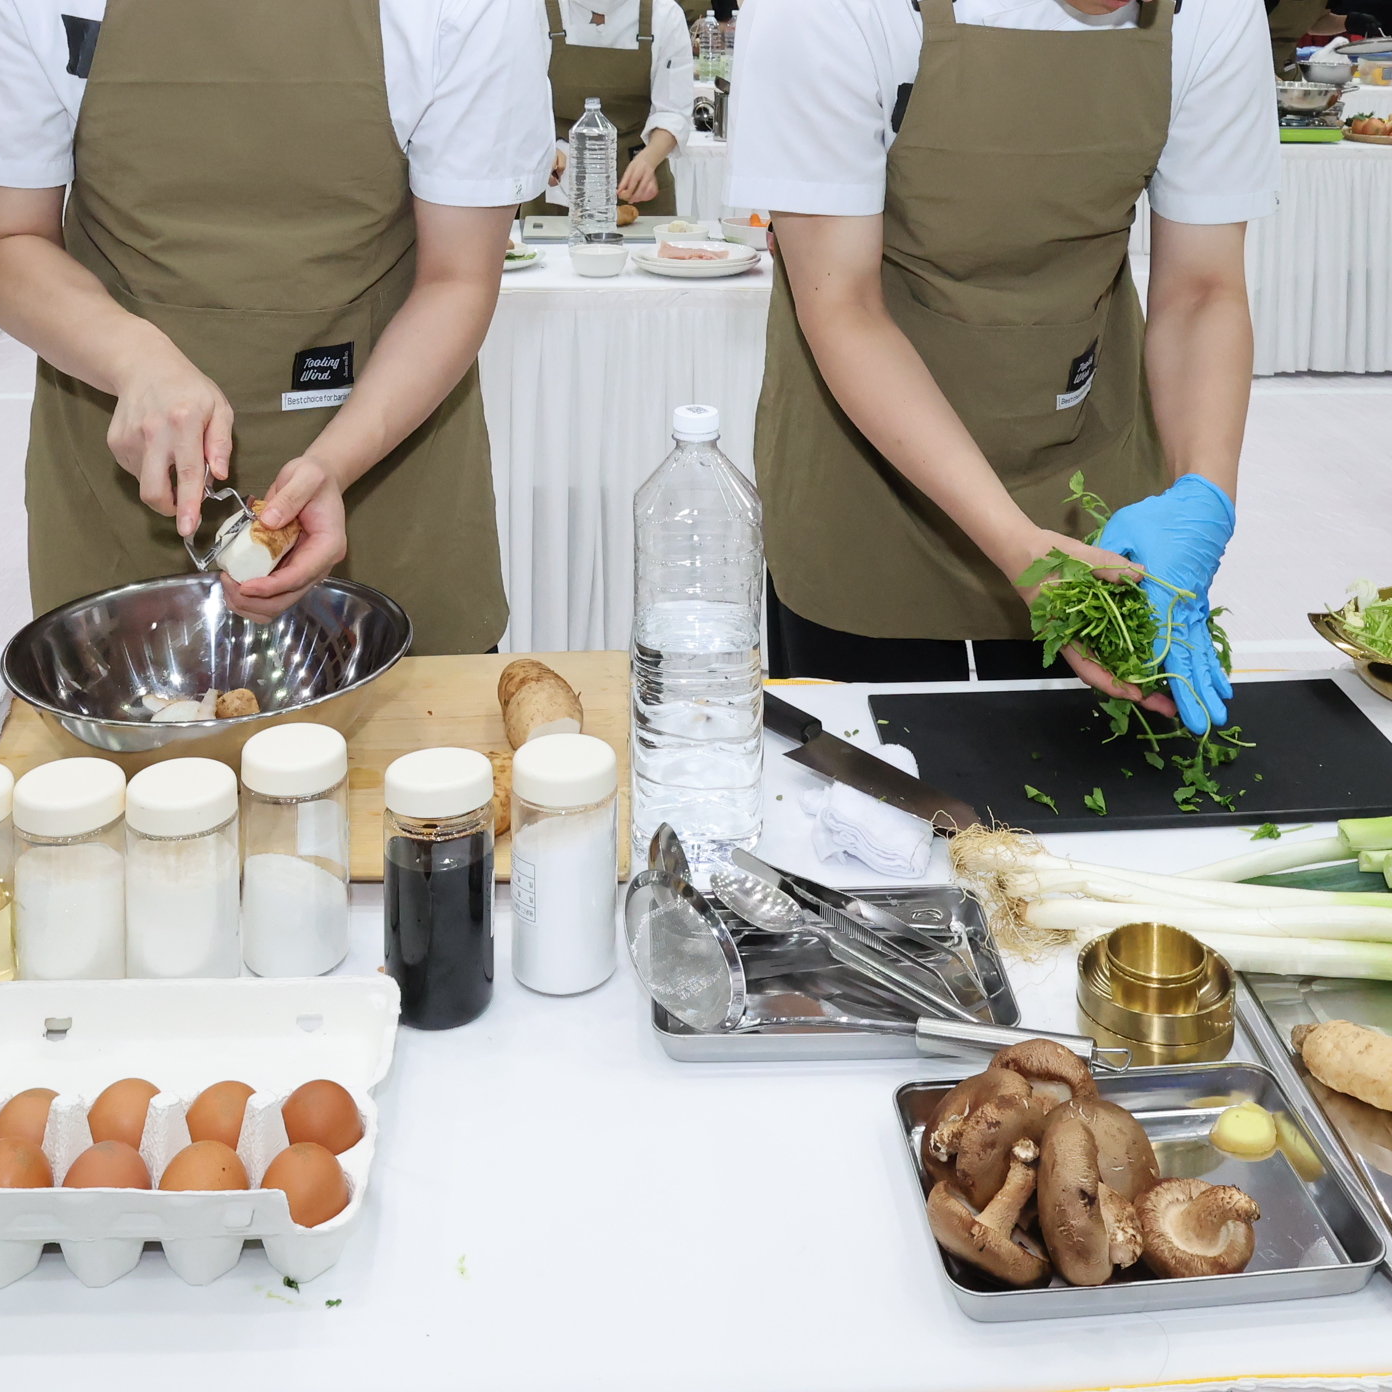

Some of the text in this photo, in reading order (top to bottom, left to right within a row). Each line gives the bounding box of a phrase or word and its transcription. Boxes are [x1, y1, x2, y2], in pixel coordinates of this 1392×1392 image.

[303, 356, 340, 370] Tooling
[300, 369, 331, 382] Wind
[288, 392, 350, 406] Best choice for baris
